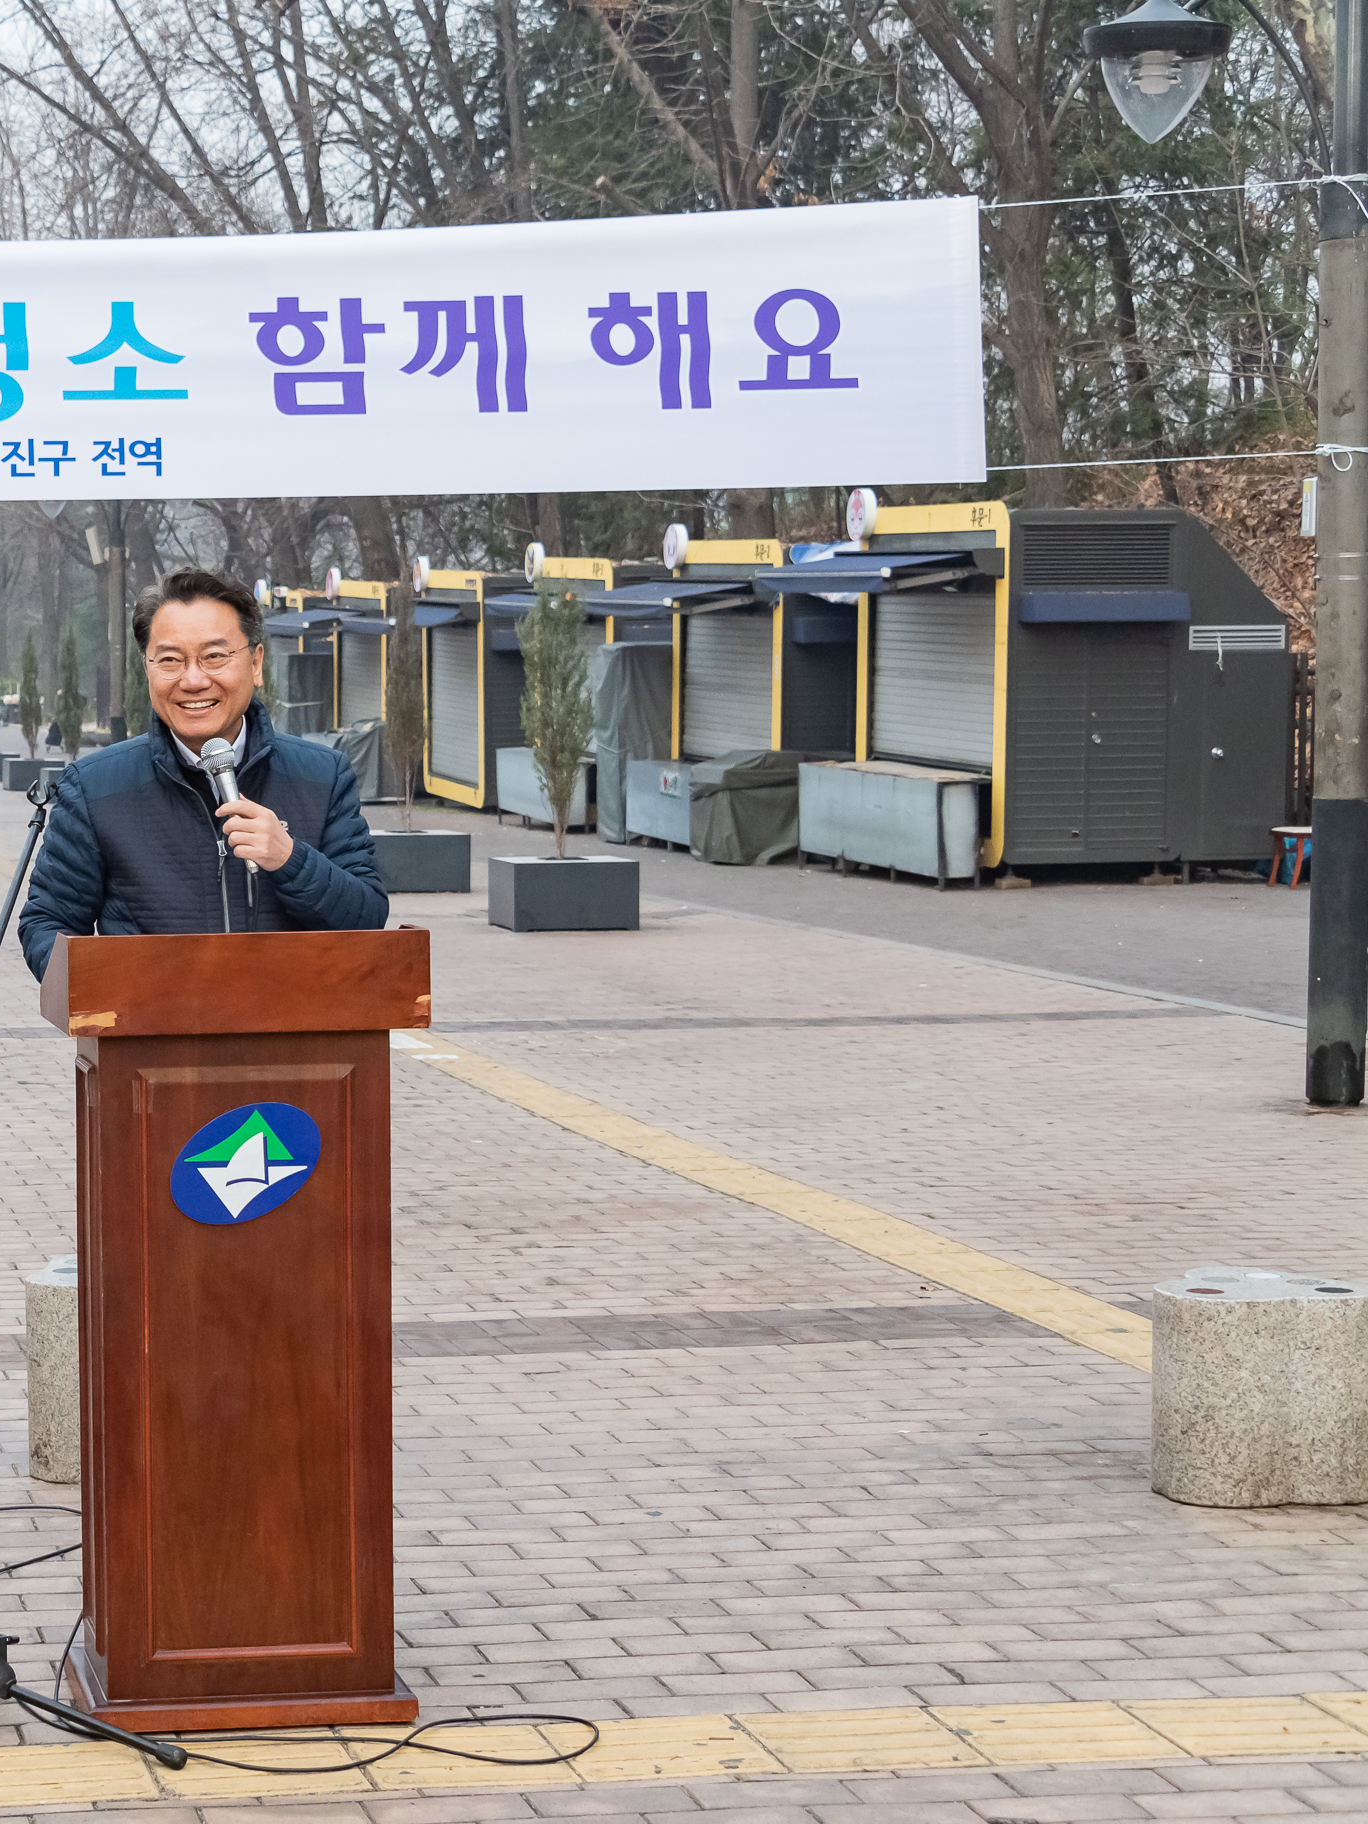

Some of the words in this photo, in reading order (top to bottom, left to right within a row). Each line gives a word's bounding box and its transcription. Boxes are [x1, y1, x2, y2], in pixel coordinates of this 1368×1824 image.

[248, 294, 528, 416] 함께
[587, 288, 860, 410] 해요
[91, 436, 163, 478] 전역
